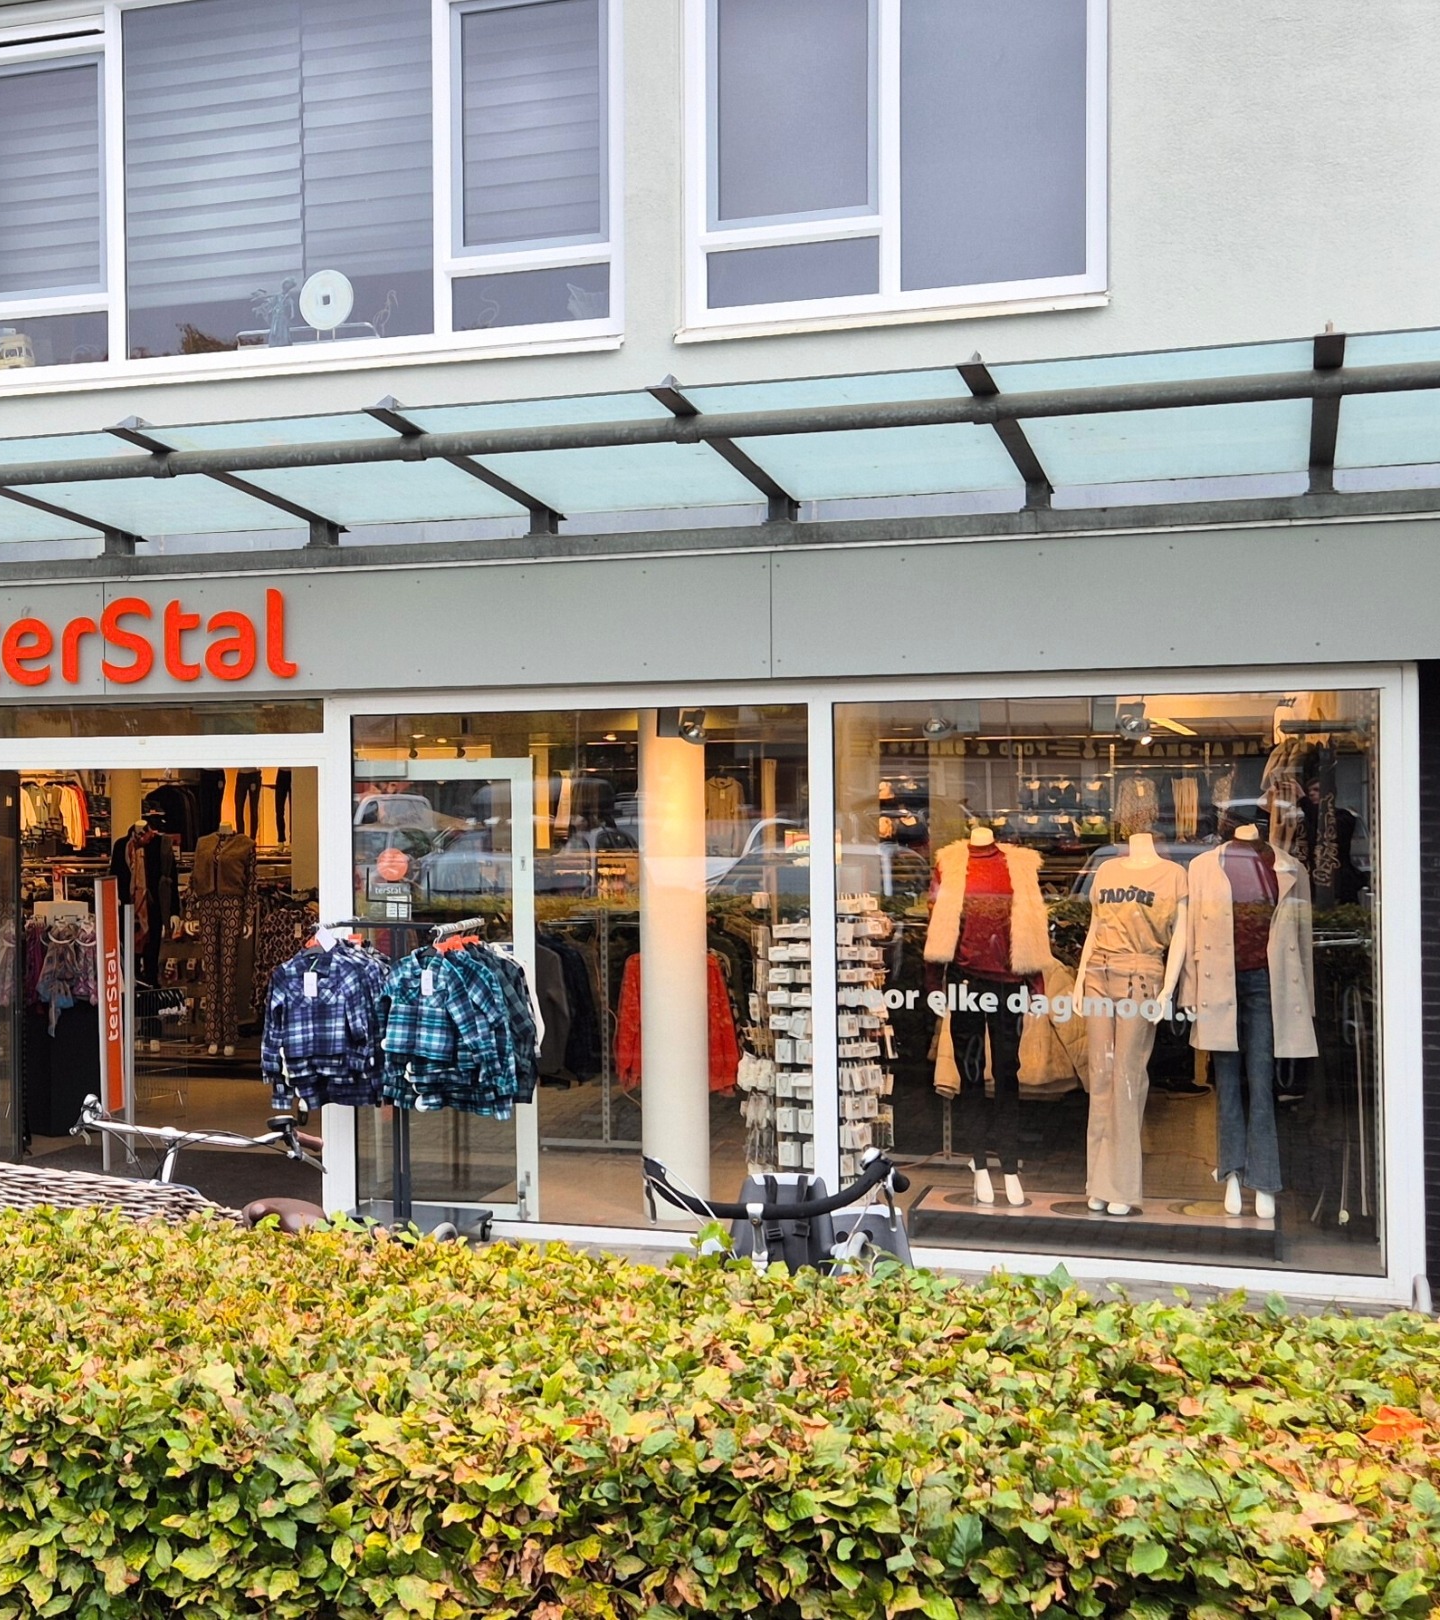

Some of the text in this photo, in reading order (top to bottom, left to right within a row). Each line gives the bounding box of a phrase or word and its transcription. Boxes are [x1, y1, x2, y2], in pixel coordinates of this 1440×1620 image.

[374, 886, 402, 895] terStal
[105, 948, 120, 1042] terStal
[927, 984, 998, 1012] elke
[1006, 986, 1073, 1022] dag
